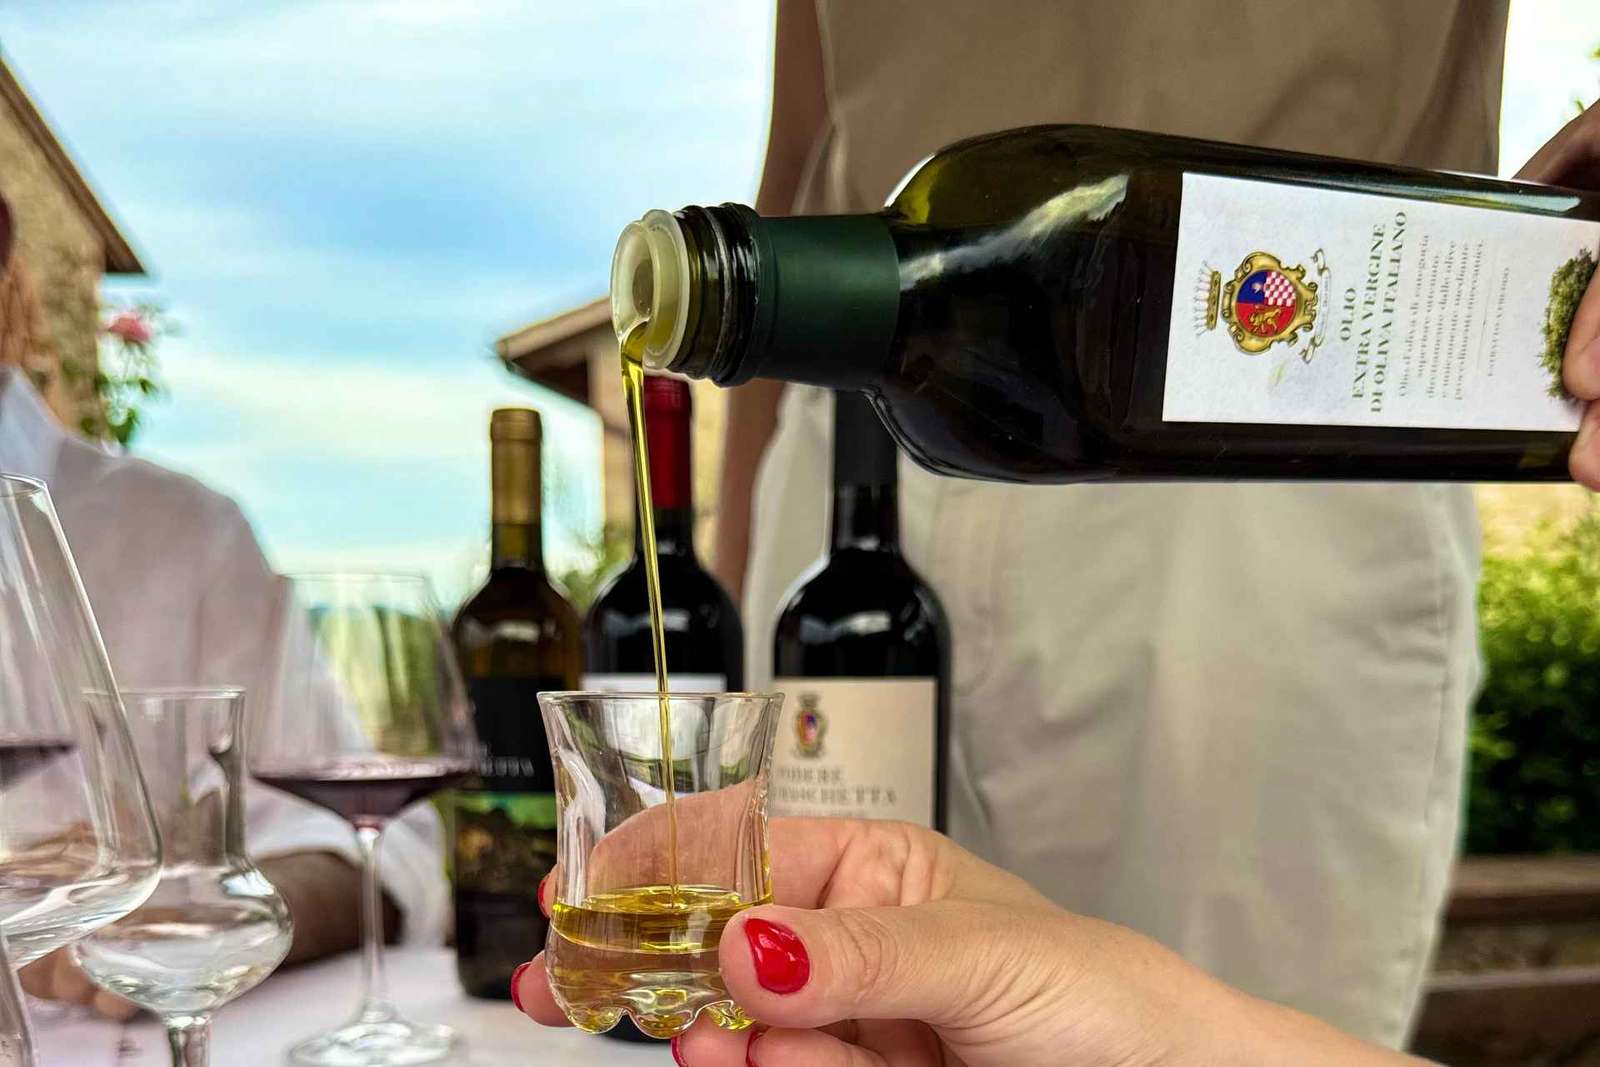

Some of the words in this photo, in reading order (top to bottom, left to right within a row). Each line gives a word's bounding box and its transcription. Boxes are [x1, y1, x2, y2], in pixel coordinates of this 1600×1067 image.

[1361, 223, 1386, 321] VERGINE
[1383, 211, 1407, 313] ITALIANO
[1415, 235, 1429, 298] categoria
[1444, 241, 1456, 274] olive
[1340, 287, 1356, 341] OLIO
[1439, 278, 1450, 311] dalle
[1352, 327, 1372, 398] EXTRA
[1374, 320, 1392, 385] OLIVA
[1371, 392, 1383, 412] DI
